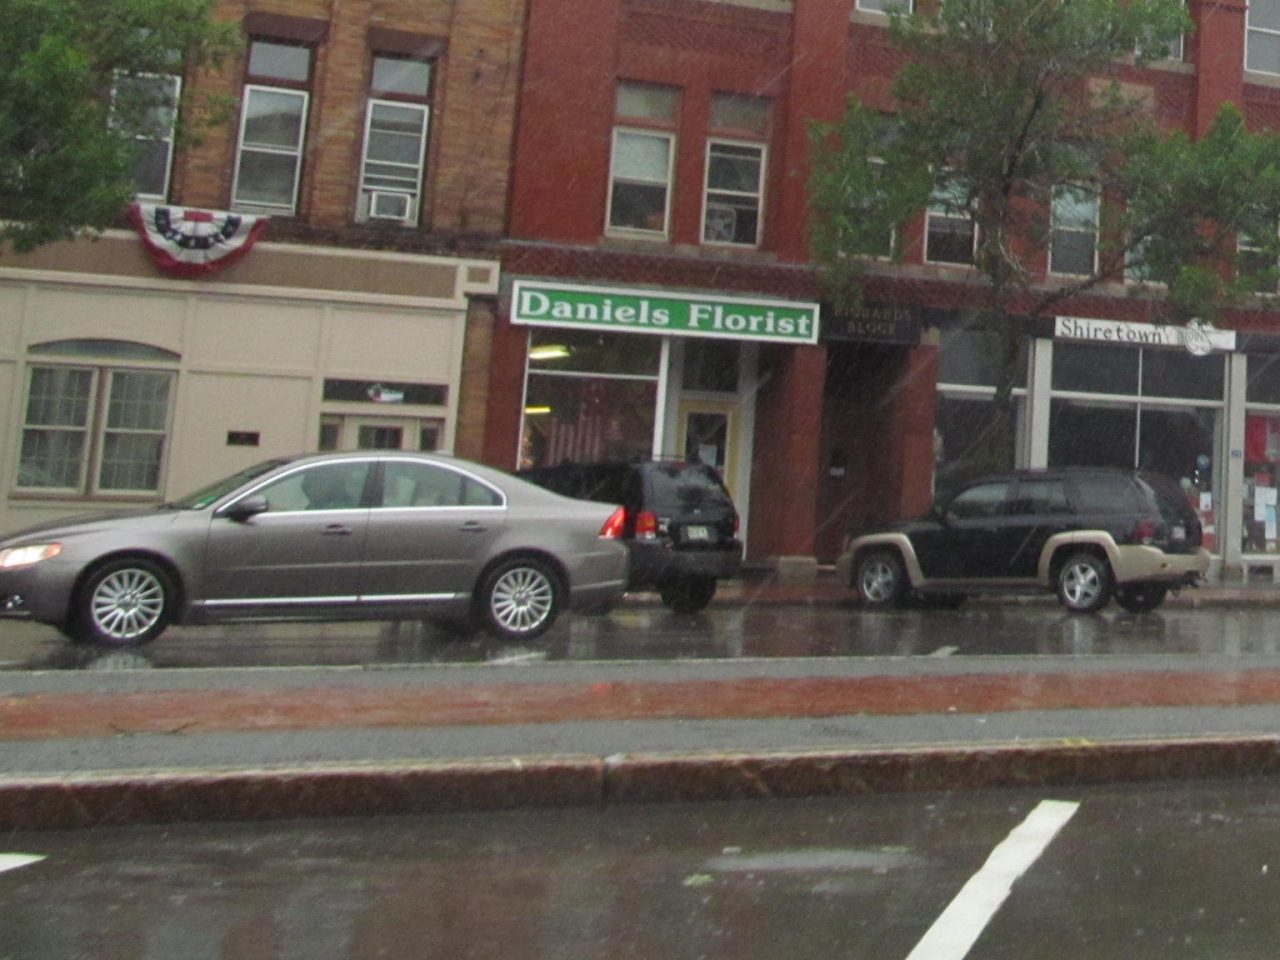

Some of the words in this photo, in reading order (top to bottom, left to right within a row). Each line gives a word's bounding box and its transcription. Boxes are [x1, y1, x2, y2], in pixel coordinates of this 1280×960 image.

[519, 290, 670, 326] Daniels
[687, 303, 811, 335] Florist
[1060, 318, 1163, 344] Shiretown
